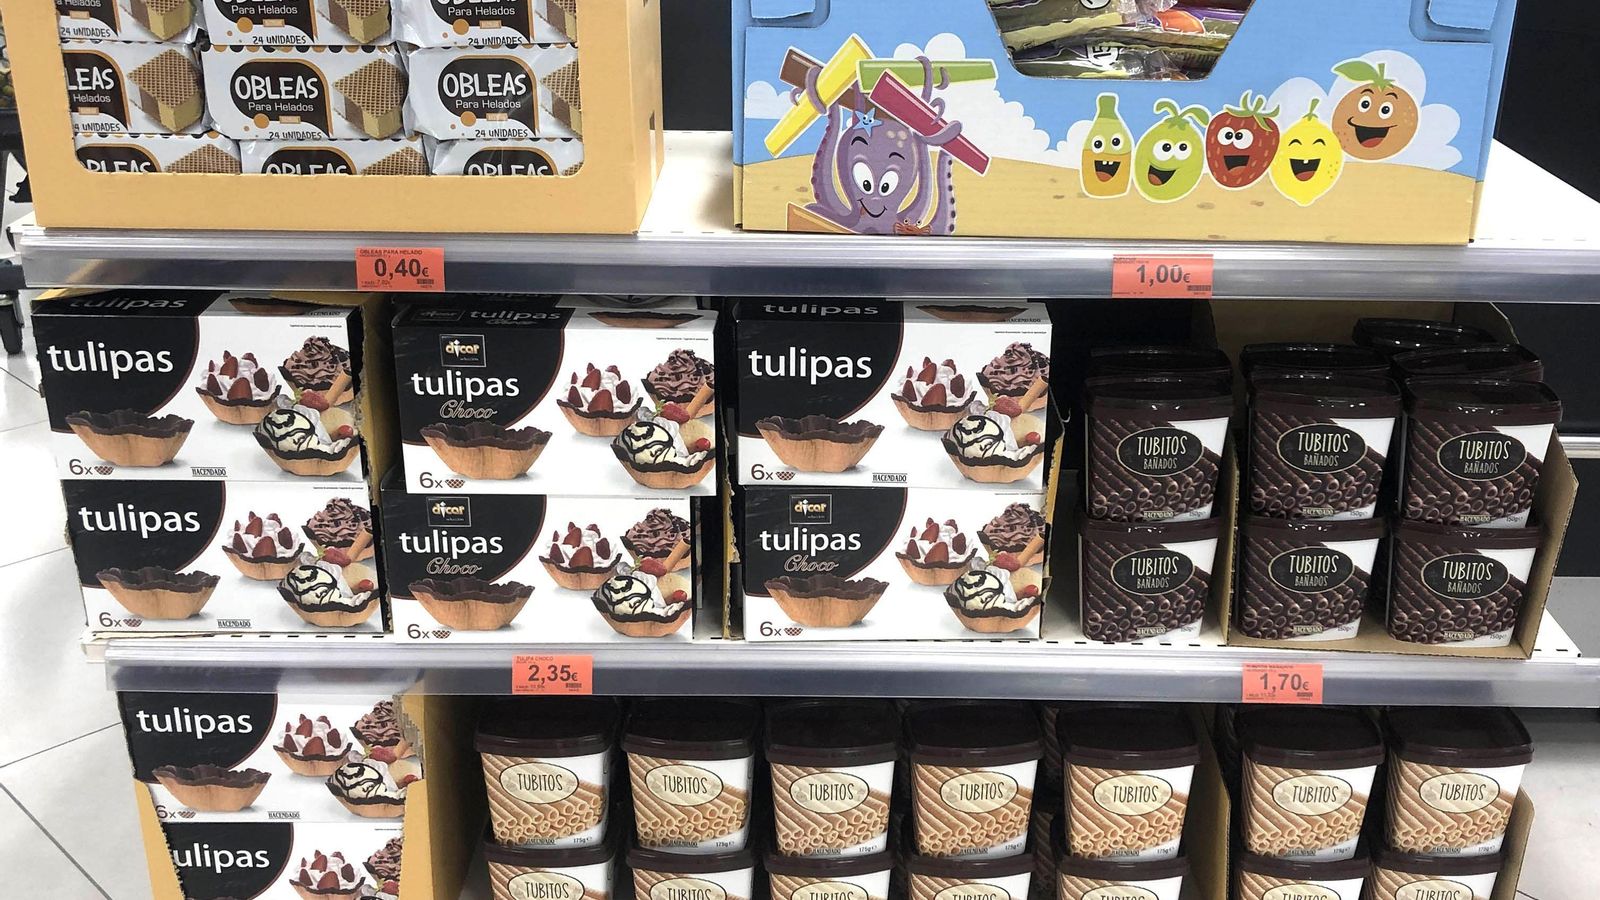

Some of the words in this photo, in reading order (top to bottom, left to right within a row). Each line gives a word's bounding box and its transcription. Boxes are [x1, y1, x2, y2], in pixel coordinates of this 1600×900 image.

[232, 6, 254, 14] Para
[258, 5, 297, 14] Helados
[448, 7, 471, 16] Para
[475, 6, 515, 16] Helados
[61, 27, 70, 36] 24
[74, 28, 111, 38] UNIDADES
[253, 36, 263, 44] 24
[266, 36, 306, 44] UNIDADES
[482, 37, 522, 45] UNIDADES
[67, 67, 114, 90] LEAS
[443, 72, 526, 98] OBLEAS
[235, 76, 318, 100] OBLEAS
[74, 94, 111, 103] Helados
[248, 102, 271, 112] Para
[275, 102, 314, 112] Helados
[456, 100, 479, 109] Para
[482, 100, 521, 109] Helados
[82, 123, 120, 132] UNIDADES
[269, 132, 280, 140] 24
[283, 132, 322, 140] UNIDADES
[476, 130, 486, 138] 24
[489, 129, 528, 138] UNIDADES
[375, 258, 429, 280] 0,40€
[1137, 264, 1190, 287] 1,00€
[470, 310, 561, 320] tulipas
[764, 304, 879, 316] tulipas
[47, 340, 174, 378] tulipas
[748, 347, 872, 385] tulipas
[410, 370, 520, 402] tulipas
[440, 399, 498, 419] Choco
[1137, 436, 1188, 456] TUBITOS
[1298, 432, 1350, 453] TUBITOS
[1459, 440, 1511, 460] TUBITOS
[69, 458, 93, 476] 6x
[1143, 457, 1177, 470] BAÑADOS
[1304, 453, 1339, 466] BAÑADOS
[1464, 461, 1499, 474] BAÑADOS
[419, 472, 443, 489] 6x
[751, 464, 773, 481] 6x
[78, 503, 201, 538] tulipas
[399, 530, 503, 559] tulipas
[760, 526, 861, 556] tulipas
[426, 557, 482, 575] Choco
[784, 554, 839, 572] Choco
[1131, 556, 1179, 576] TUBITOS
[1289, 555, 1339, 574] TUBITOS
[1442, 561, 1493, 580] TUBITOS
[1136, 577, 1169, 589] BAÑADOS
[1294, 575, 1329, 587] BAÑADOS
[1448, 582, 1482, 594] BAÑADOS
[99, 612, 122, 628] 6x
[760, 621, 781, 636] 6x
[407, 623, 430, 639] 6x
[528, 664, 577, 684] 2,35€
[1260, 673, 1309, 693] 1,70€
[136, 707, 253, 739] tulipas
[517, 773, 563, 791] TUBITOS
[662, 775, 708, 794] TUBITOS
[959, 782, 1004, 800] TUBITOS
[808, 784, 854, 801] TUBITOS
[1113, 785, 1158, 803] TUBITOS
[1292, 785, 1338, 803] TUBITOS
[1439, 782, 1486, 801] TUBITOS
[156, 805, 176, 819] 6x
[173, 842, 270, 874] ulipas
[525, 882, 569, 899] TUBITOS
